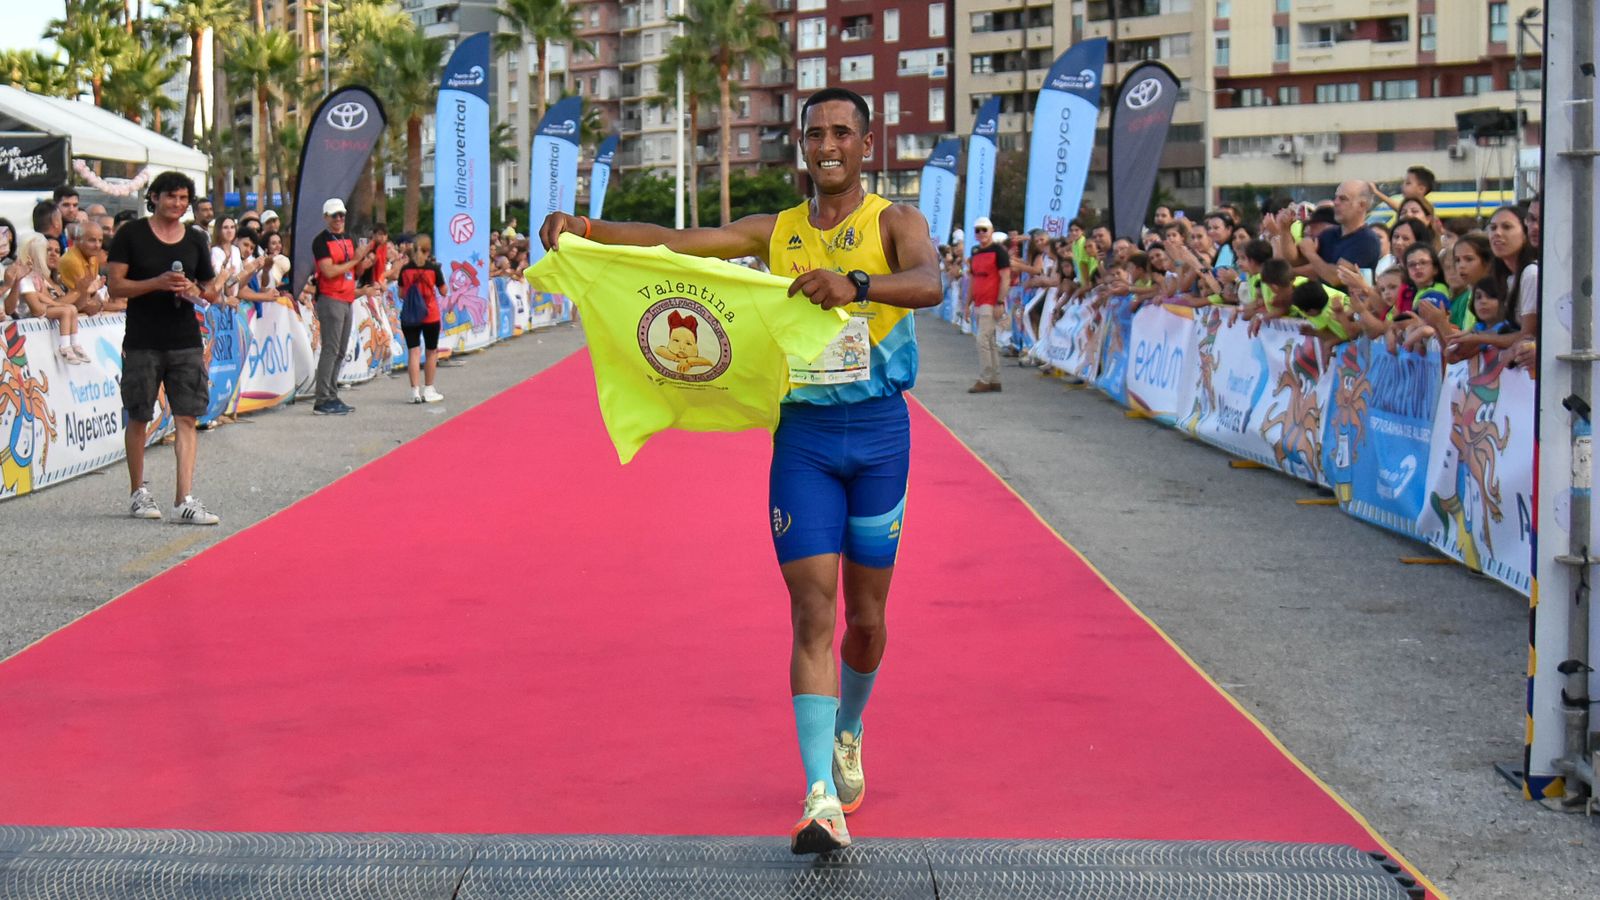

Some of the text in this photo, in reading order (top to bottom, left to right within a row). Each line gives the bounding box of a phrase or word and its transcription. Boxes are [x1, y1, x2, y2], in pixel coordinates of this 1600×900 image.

[455, 98, 467, 208] lalineavertical
[1049, 107, 1071, 212] Sergeyco
[637, 280, 735, 323] Valentina
[69, 376, 116, 404] Puerto de
[65, 406, 118, 451] Algeciras
